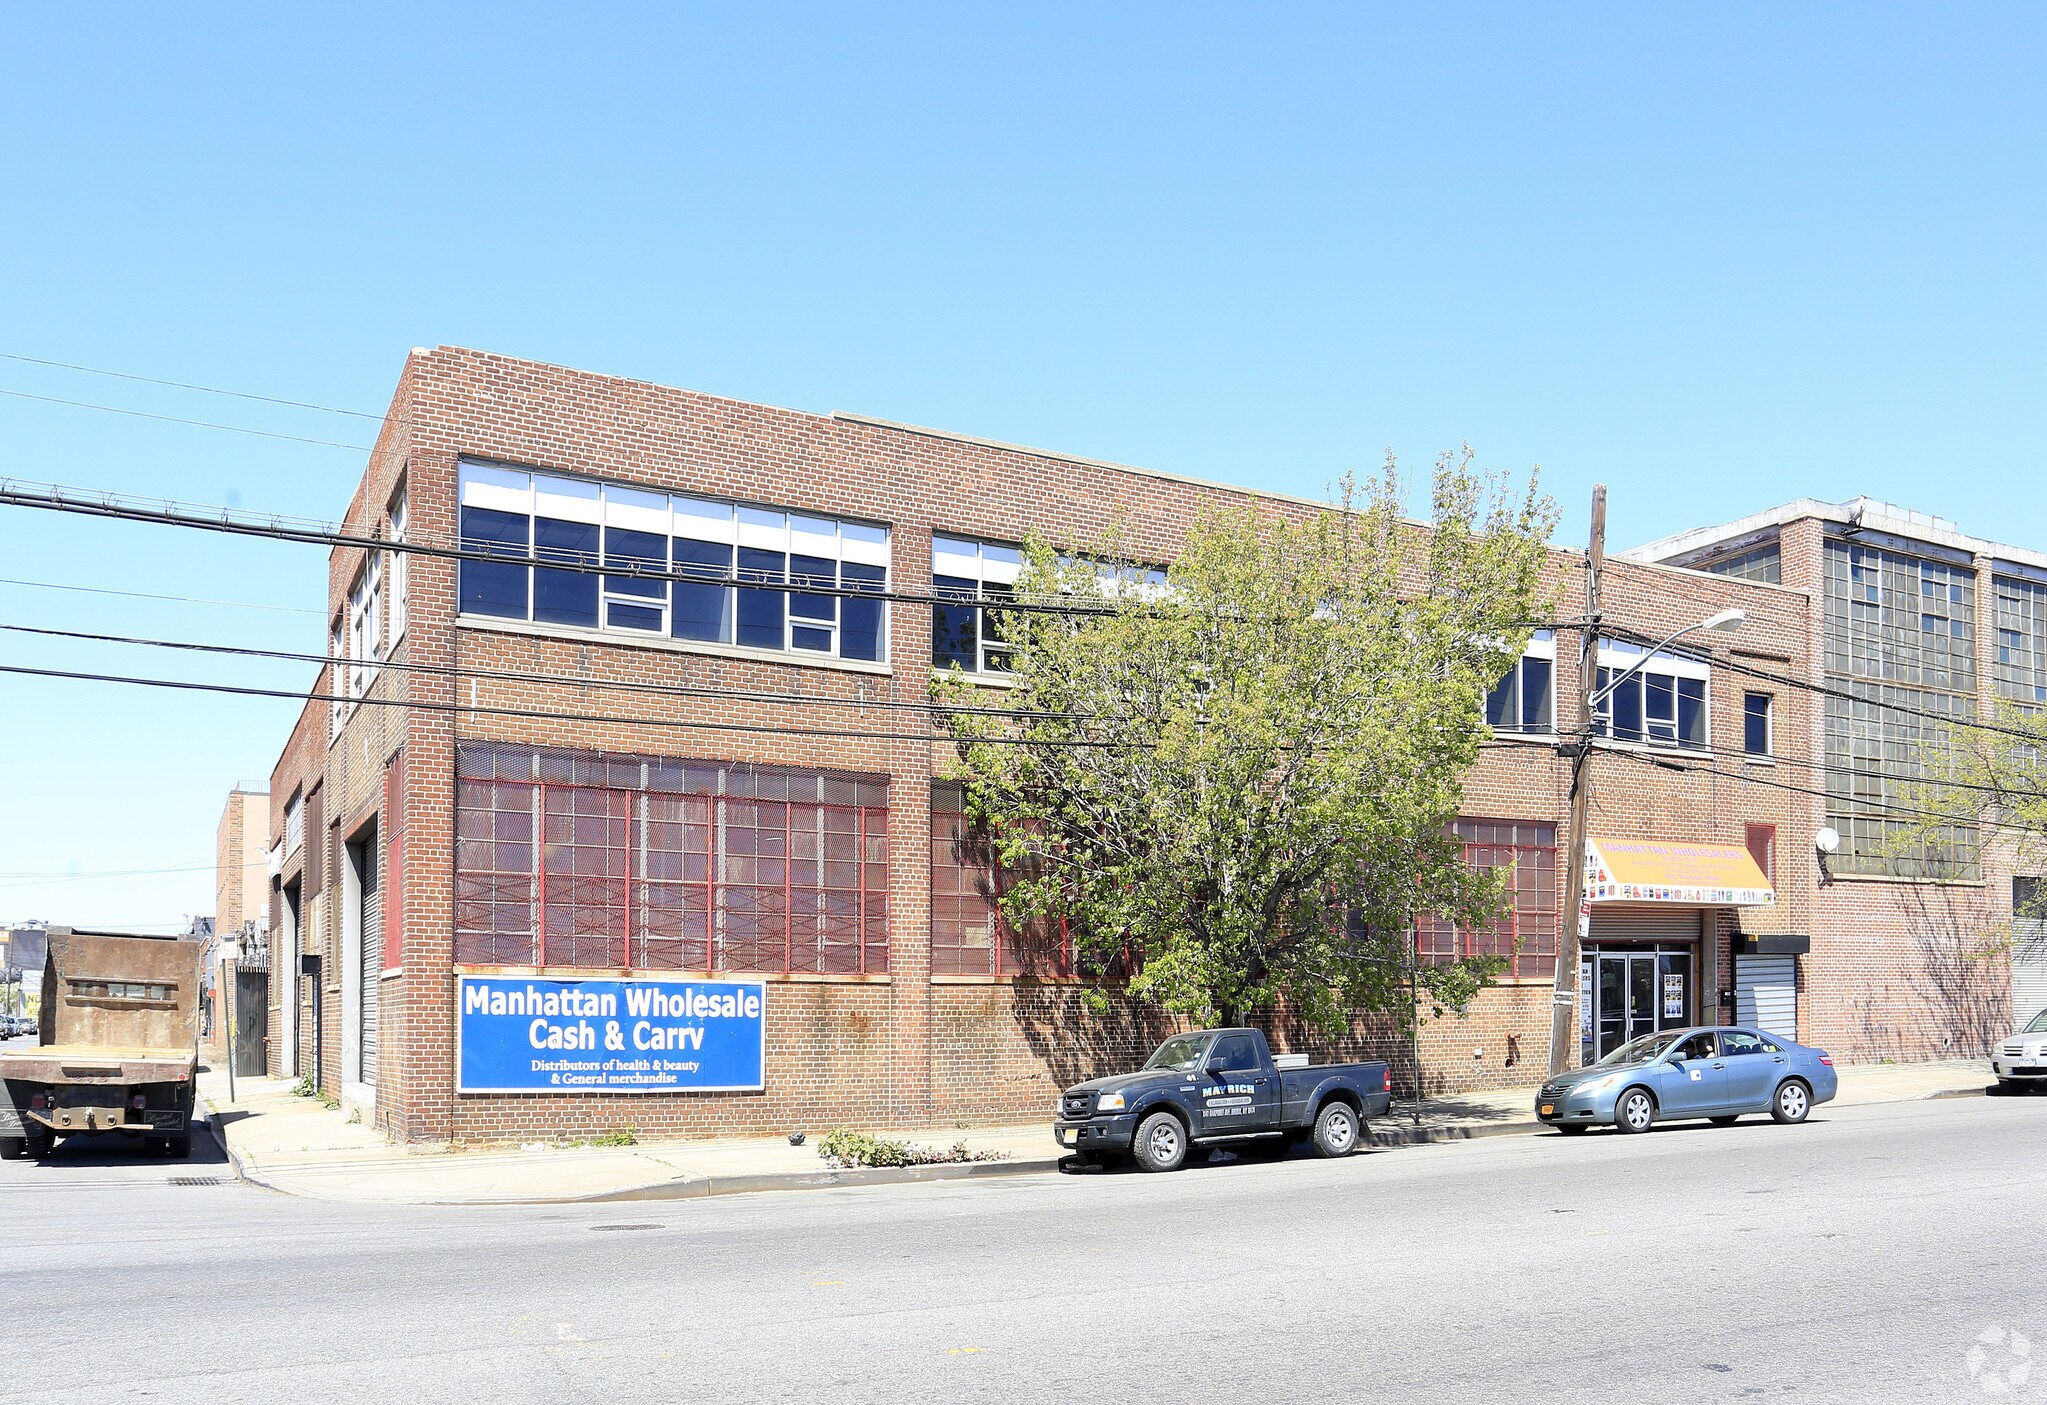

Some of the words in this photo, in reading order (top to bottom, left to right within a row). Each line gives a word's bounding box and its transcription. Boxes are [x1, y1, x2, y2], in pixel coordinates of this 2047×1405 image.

[1600, 843, 1669, 856] MANHATTAN
[1670, 846, 1744, 859] WHOLESALERS
[465, 984, 617, 1017] Manhattan
[625, 987, 760, 1018] Wholesale
[529, 1018, 596, 1050] Cash
[604, 1020, 626, 1051] &
[531, 1060, 600, 1071] Distributors
[602, 1058, 615, 1071] of
[616, 1059, 650, 1071] health
[652, 1060, 662, 1071] &
[663, 1059, 700, 1074] beauty
[551, 1073, 560, 1084] &
[562, 1072, 607, 1084] General
[609, 1072, 678, 1084] merchandise
